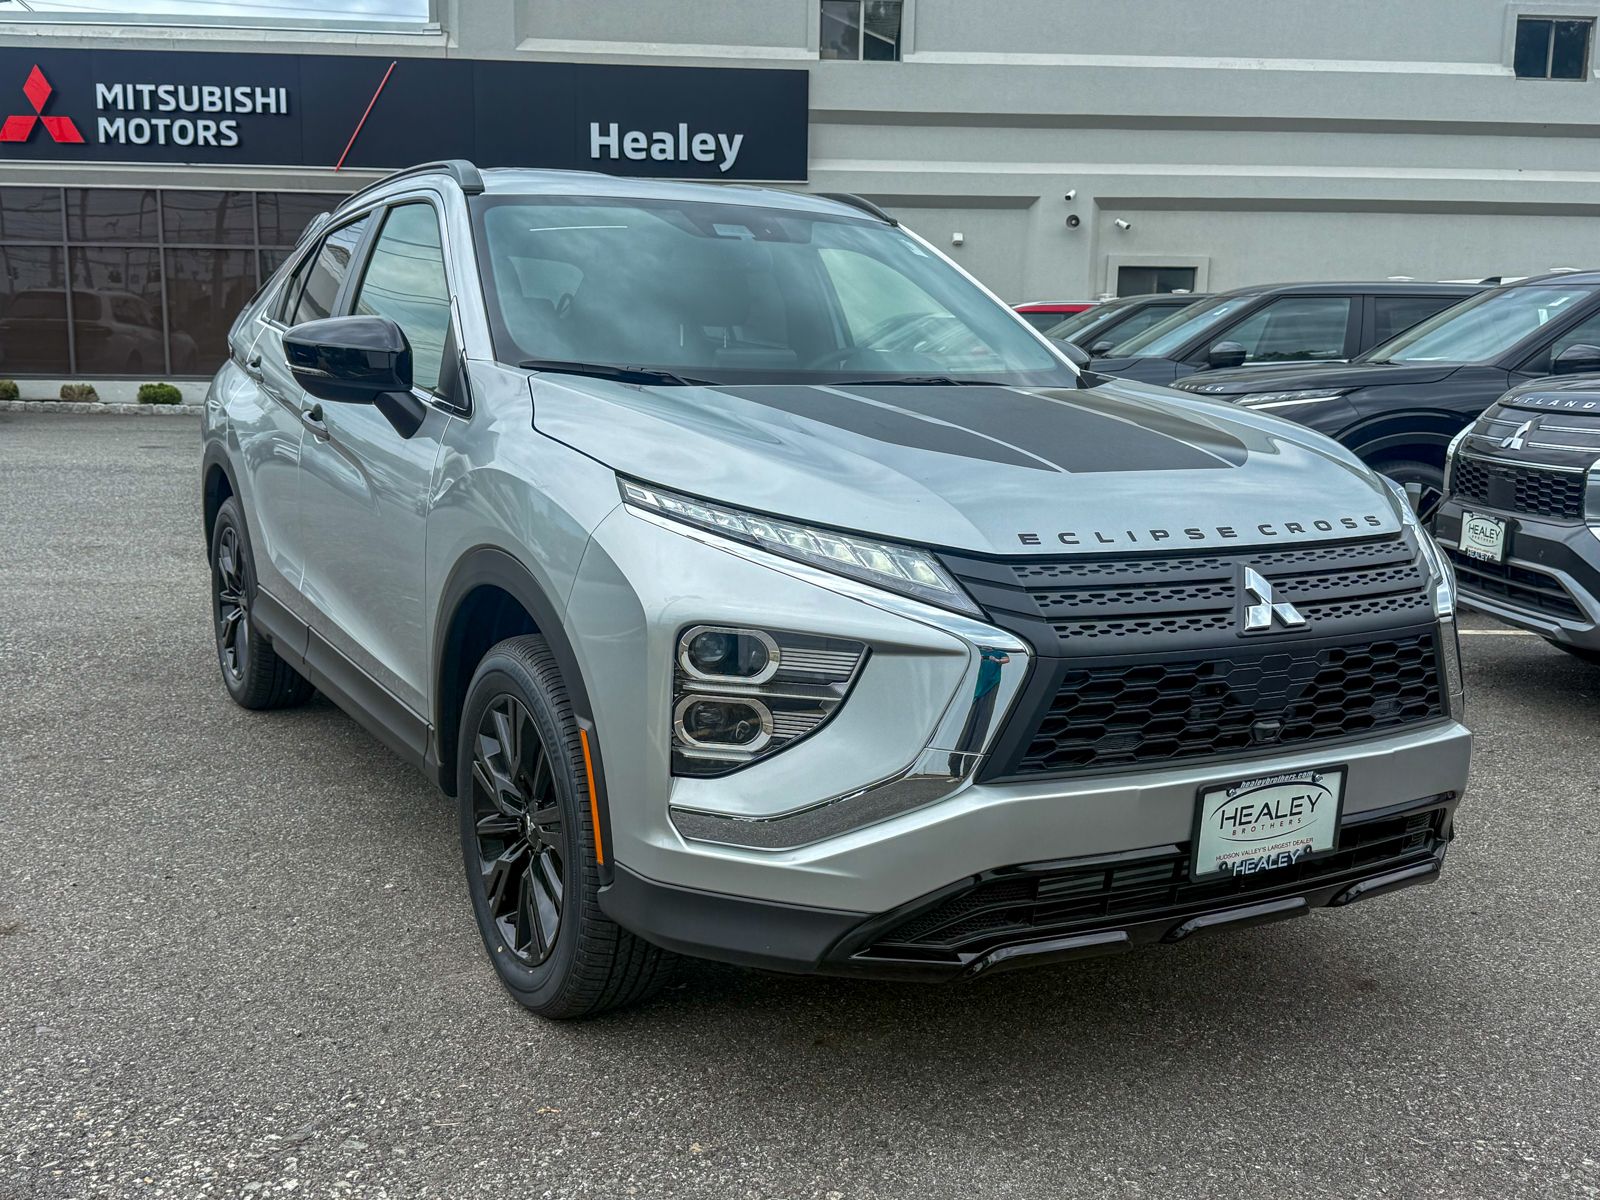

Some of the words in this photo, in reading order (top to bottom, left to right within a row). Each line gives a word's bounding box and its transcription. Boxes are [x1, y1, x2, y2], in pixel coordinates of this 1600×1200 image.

[95, 82, 288, 114] MITSUBISHI
[97, 116, 240, 147] MOTORS
[590, 122, 744, 172] Healey
[1017, 526, 1238, 546] ECLIPSE
[1257, 514, 1382, 536] CROSS
[1468, 523, 1500, 541] HEALEY
[1241, 772, 1313, 787] healeybrothers.com
[1219, 792, 1323, 830] HEALEY
[1231, 817, 1302, 836] BROTHERS
[1216, 853, 1239, 861] HUDSON
[1241, 847, 1265, 856] VALLEY'S
[1267, 841, 1291, 852] LARGEST
[1293, 838, 1313, 846] DEALER
[1233, 850, 1299, 876] HEALEY
